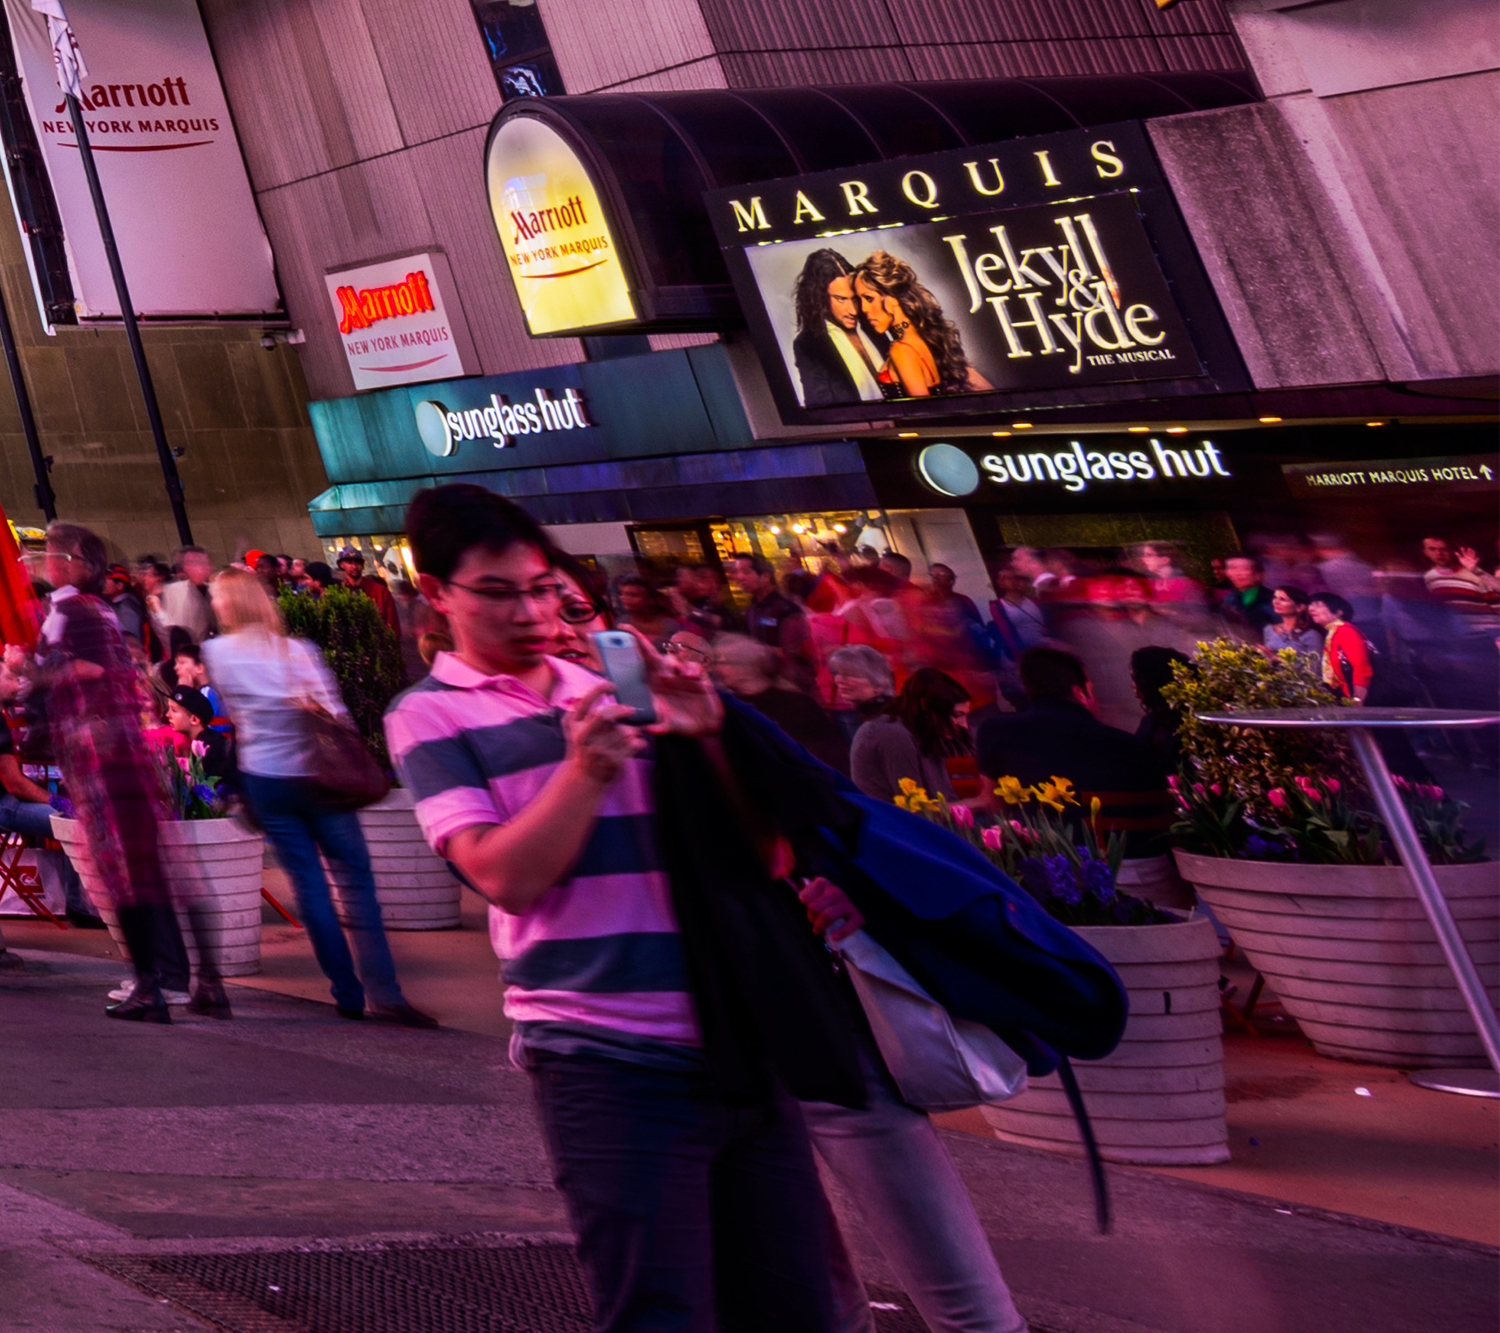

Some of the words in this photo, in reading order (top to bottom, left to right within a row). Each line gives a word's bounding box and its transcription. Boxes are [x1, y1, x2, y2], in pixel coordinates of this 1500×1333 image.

[55, 76, 190, 114] Marriott
[84, 120, 133, 134] YORK
[139, 117, 219, 133] MARQUIS
[729, 140, 1124, 233] MARQUIS
[513, 195, 588, 246] Marriott
[510, 252, 531, 266] NEW
[533, 247, 557, 263] YORK
[560, 236, 609, 258] MARQUIS
[944, 214, 1110, 313] Jekyll
[336, 271, 434, 334] Marriott
[1069, 269, 1107, 313] &
[347, 342, 372, 357] NEW
[374, 338, 398, 353] YORK
[400, 327, 449, 349] MARQUIS
[984, 292, 1166, 373] Hyde
[1086, 355, 1113, 366] THE
[1115, 348, 1176, 364] MUSICAL
[447, 389, 536, 448] sunglass
[536, 387, 585, 431] hut
[981, 442, 1153, 491] sunglass
[1153, 438, 1231, 479] hut
[1306, 470, 1368, 488] MARRIOTT
[1370, 468, 1429, 485] MARQUIS
[1432, 465, 1478, 482] HOTEL
